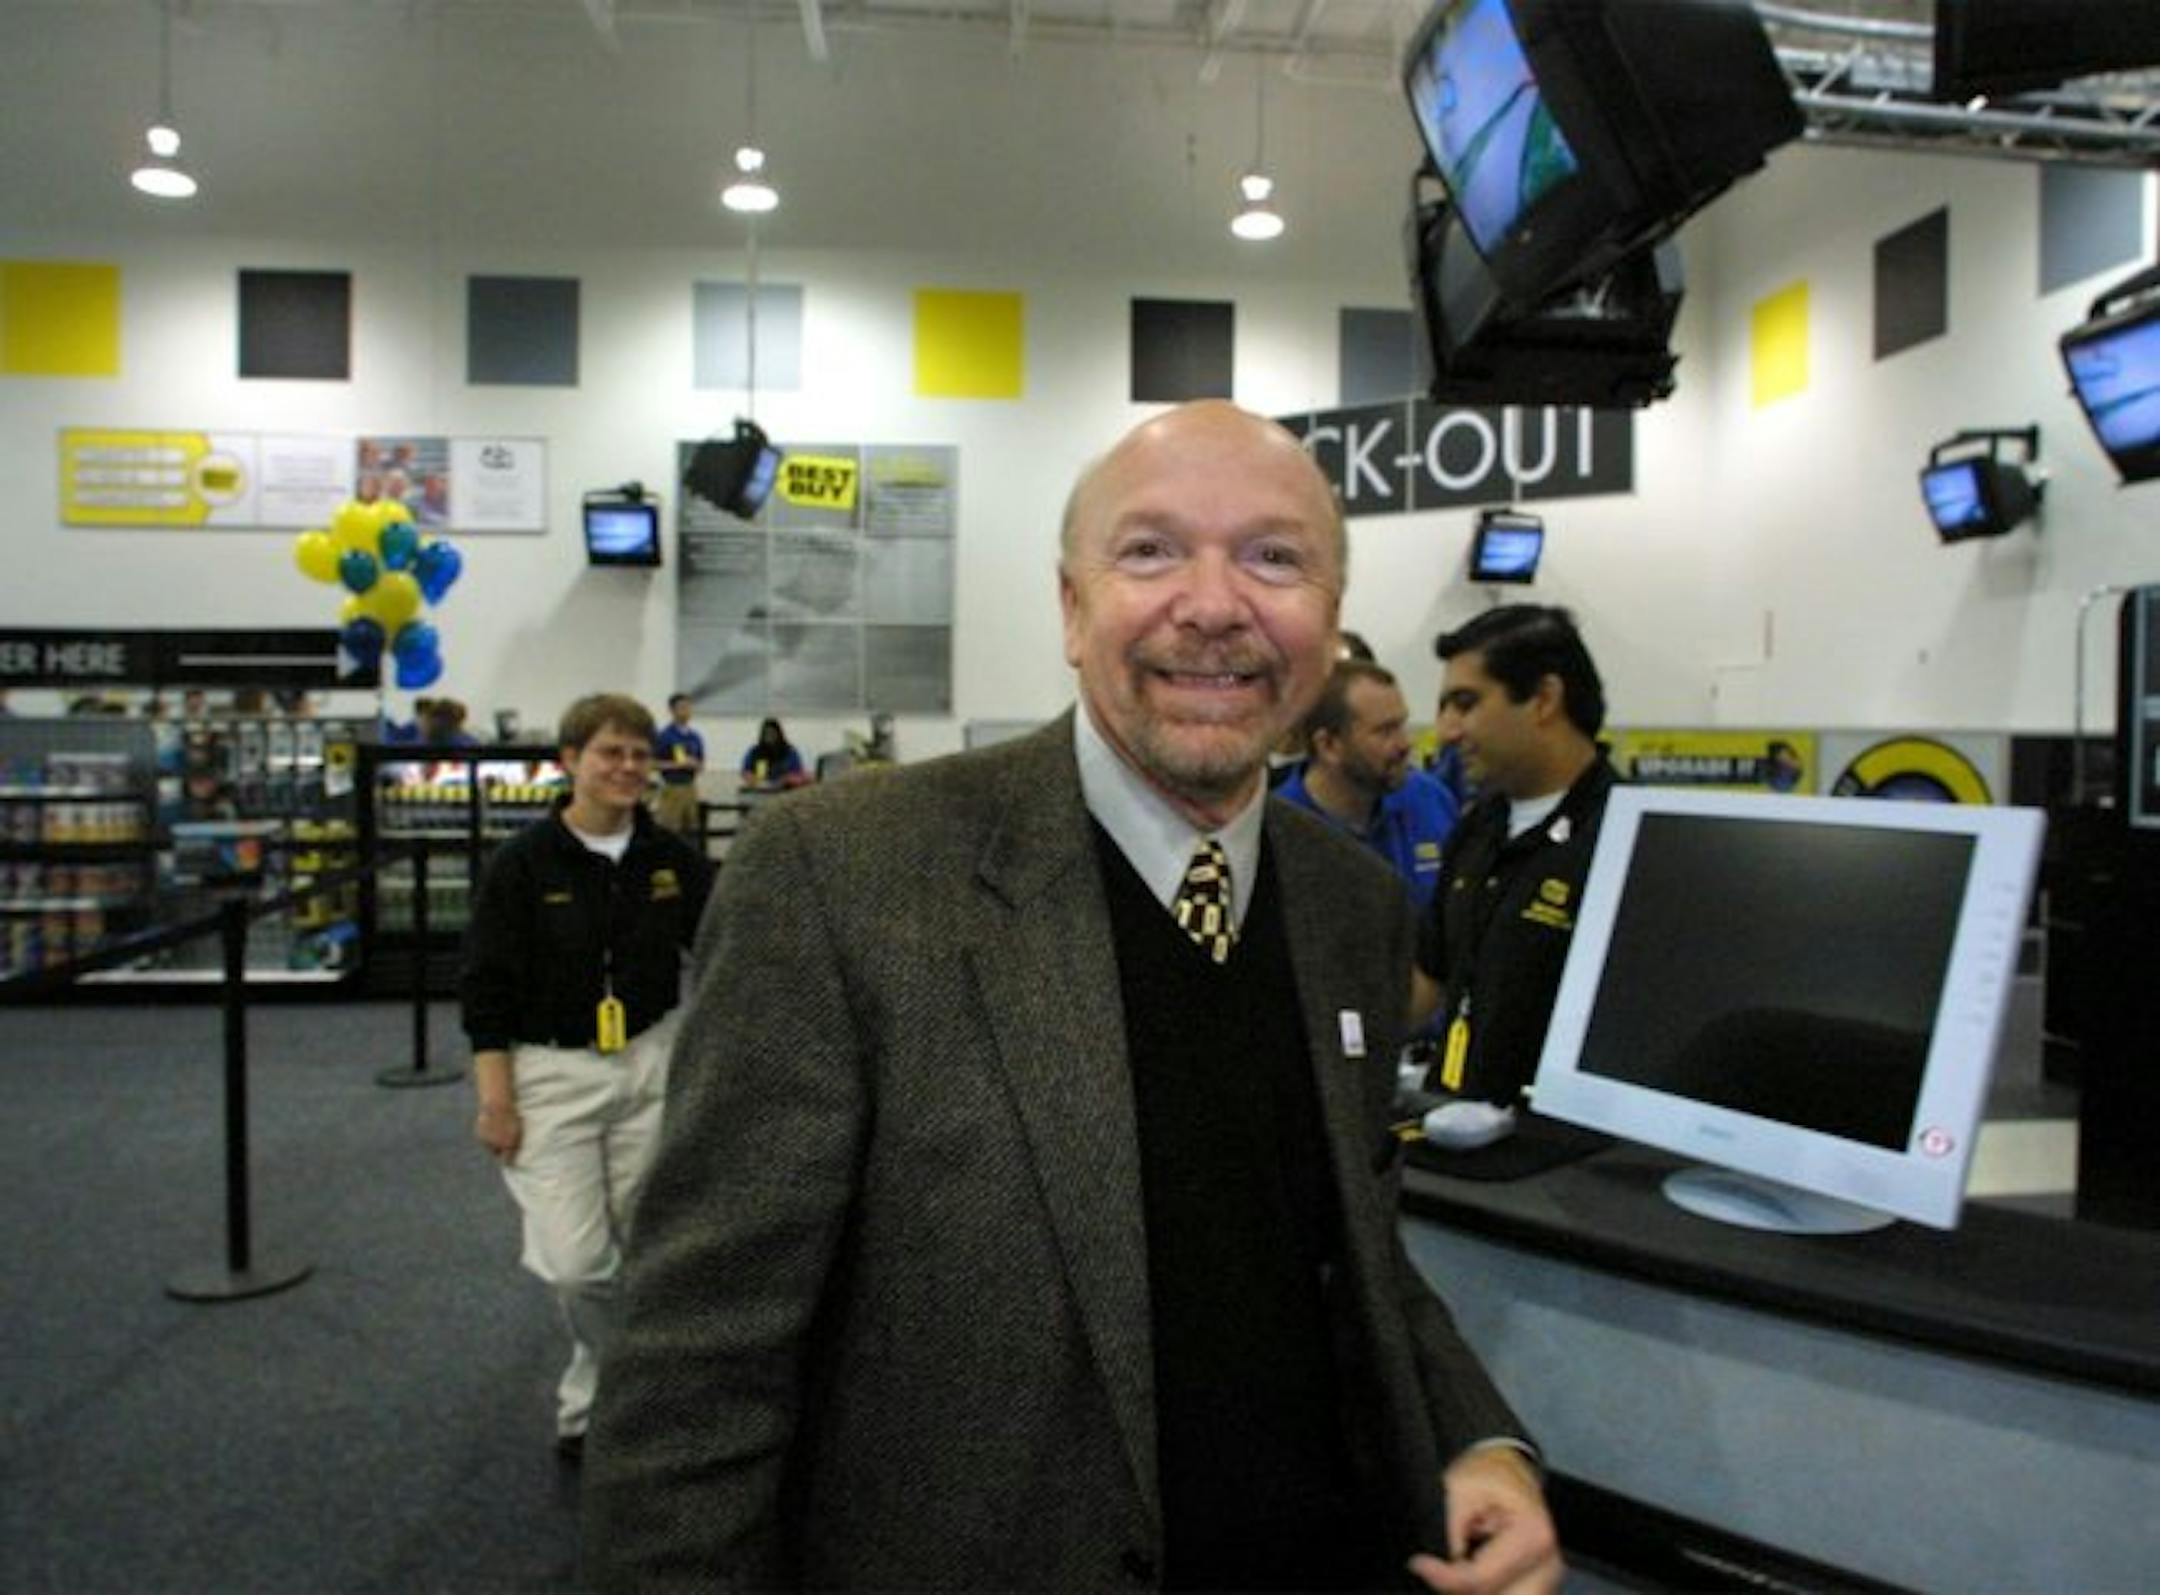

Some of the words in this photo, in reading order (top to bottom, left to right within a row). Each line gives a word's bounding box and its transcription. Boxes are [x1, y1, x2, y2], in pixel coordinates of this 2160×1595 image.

[787, 463, 851, 484] BEST
[788, 480, 843, 500] BUY
[44, 642, 126, 675] HERE
